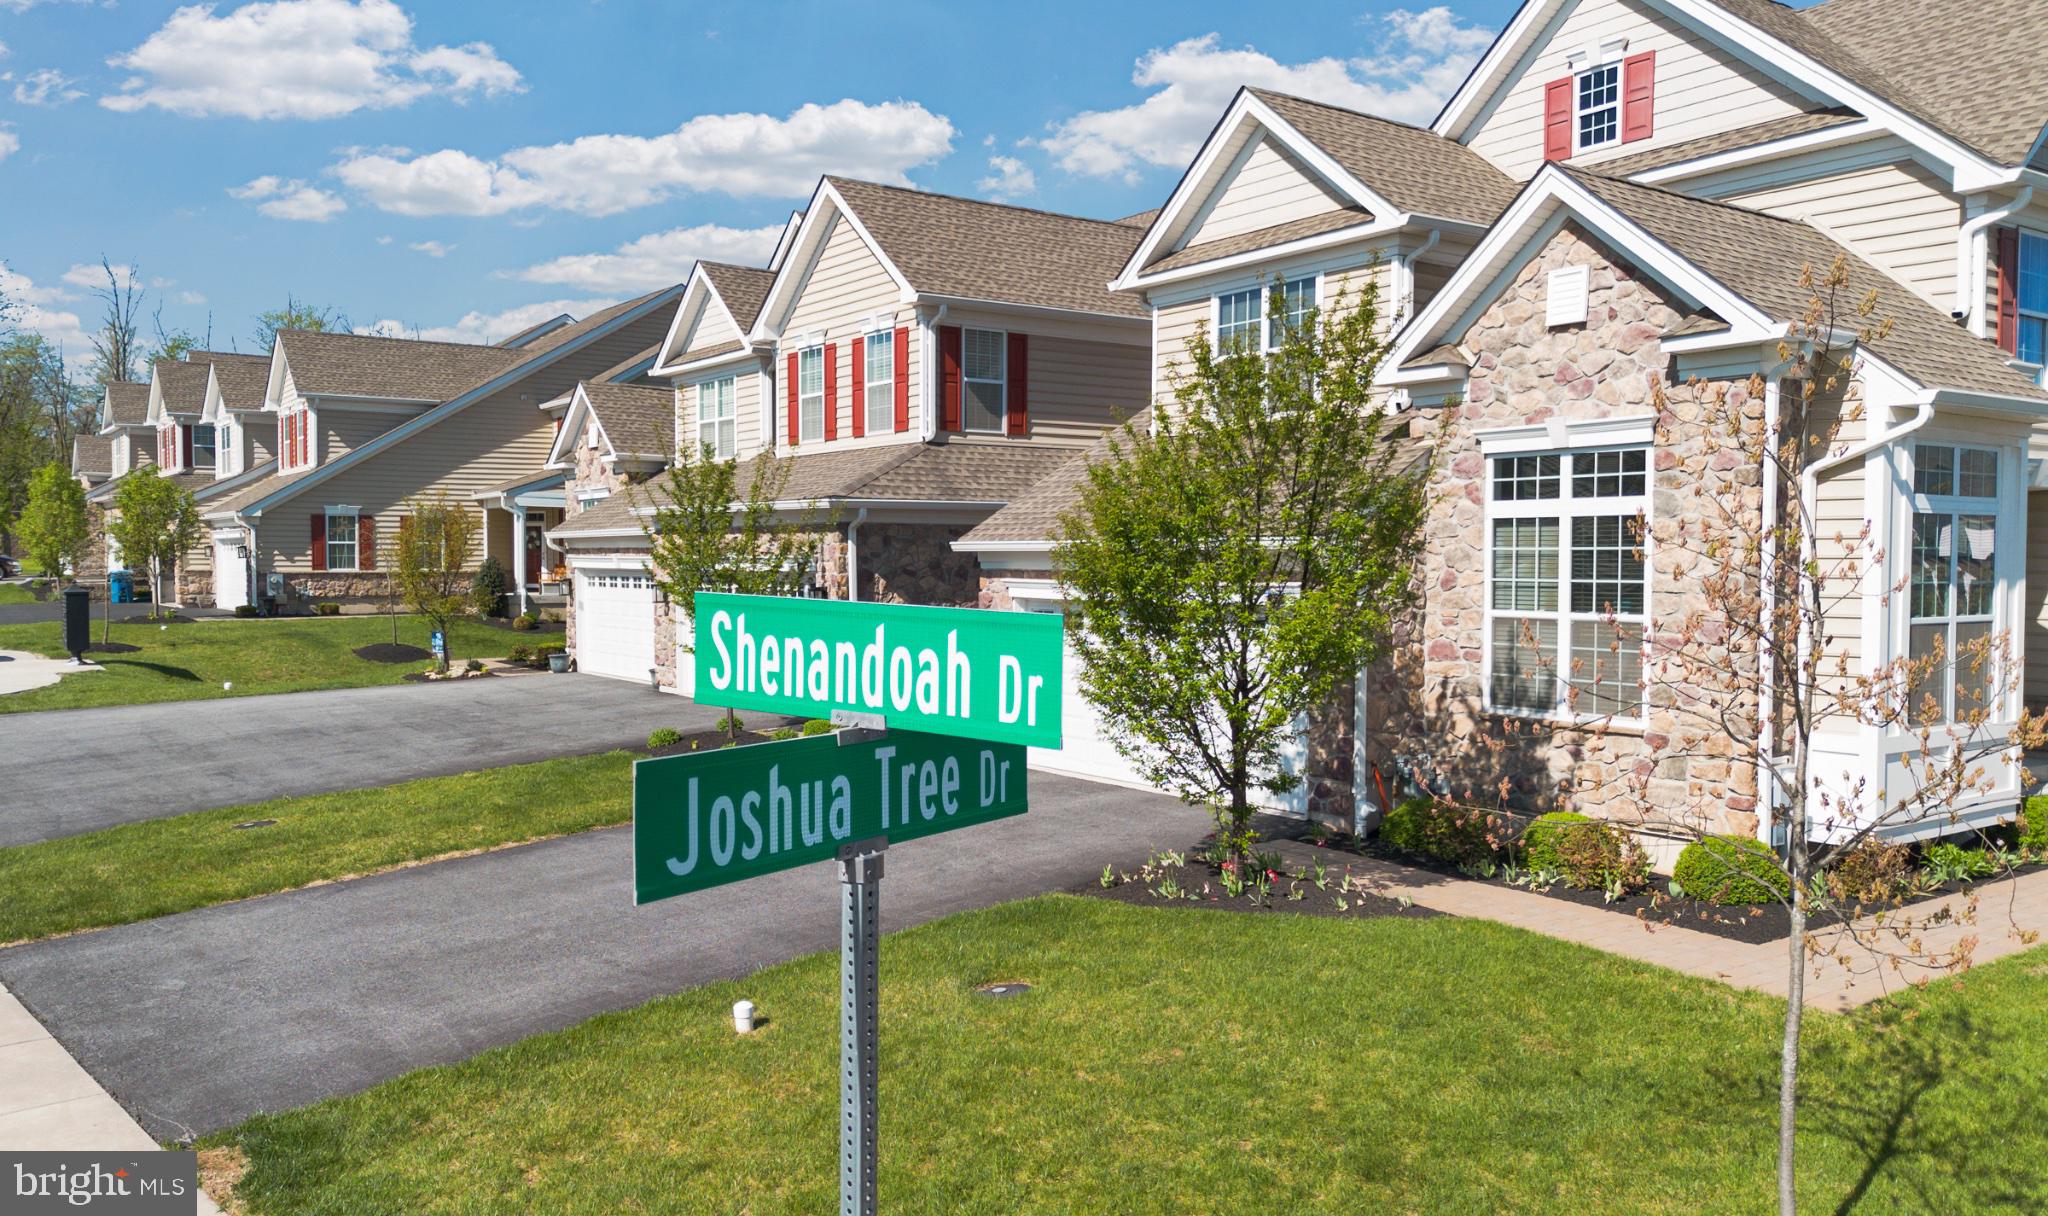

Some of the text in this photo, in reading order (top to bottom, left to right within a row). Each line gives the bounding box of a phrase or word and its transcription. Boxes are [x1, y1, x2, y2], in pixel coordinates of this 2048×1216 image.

[709, 610, 1044, 727] Shenandoah Dr
[665, 745, 1010, 876] Joshua Tree Dr
